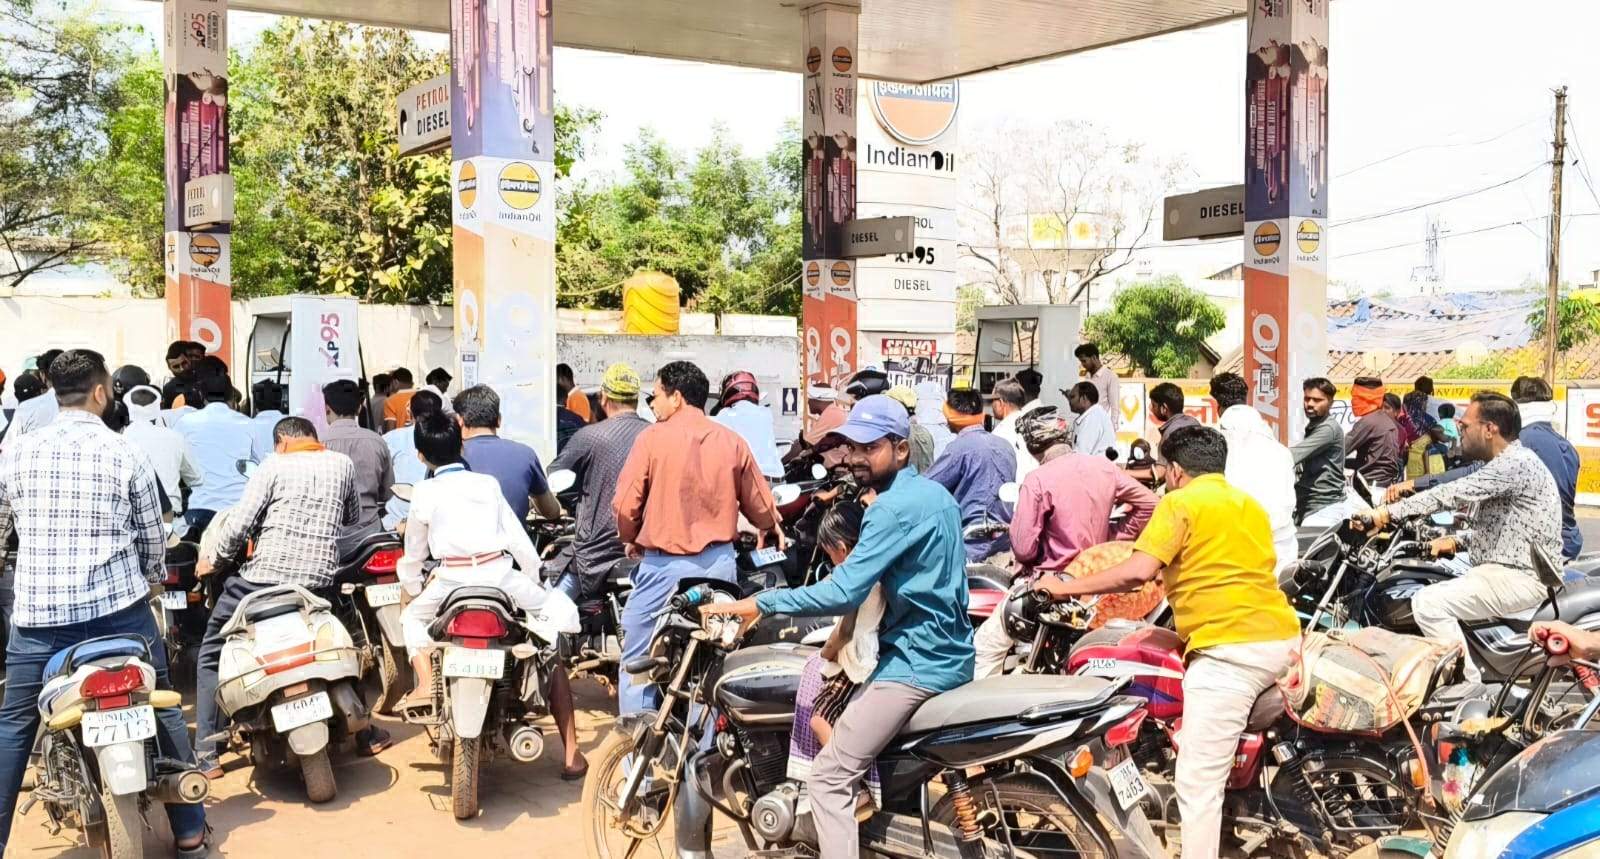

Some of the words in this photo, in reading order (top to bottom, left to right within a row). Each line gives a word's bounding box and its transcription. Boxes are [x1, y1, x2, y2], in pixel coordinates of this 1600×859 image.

[416, 84, 449, 112] PETROL
[417, 110, 449, 136] DIESEL
[867, 144, 954, 172] IndianOil
[1200, 202, 1245, 219] DIESEL
[851, 232, 879, 244] DIESEL
[894, 278, 932, 291] DIESEL
[319, 311, 341, 368] XP95
